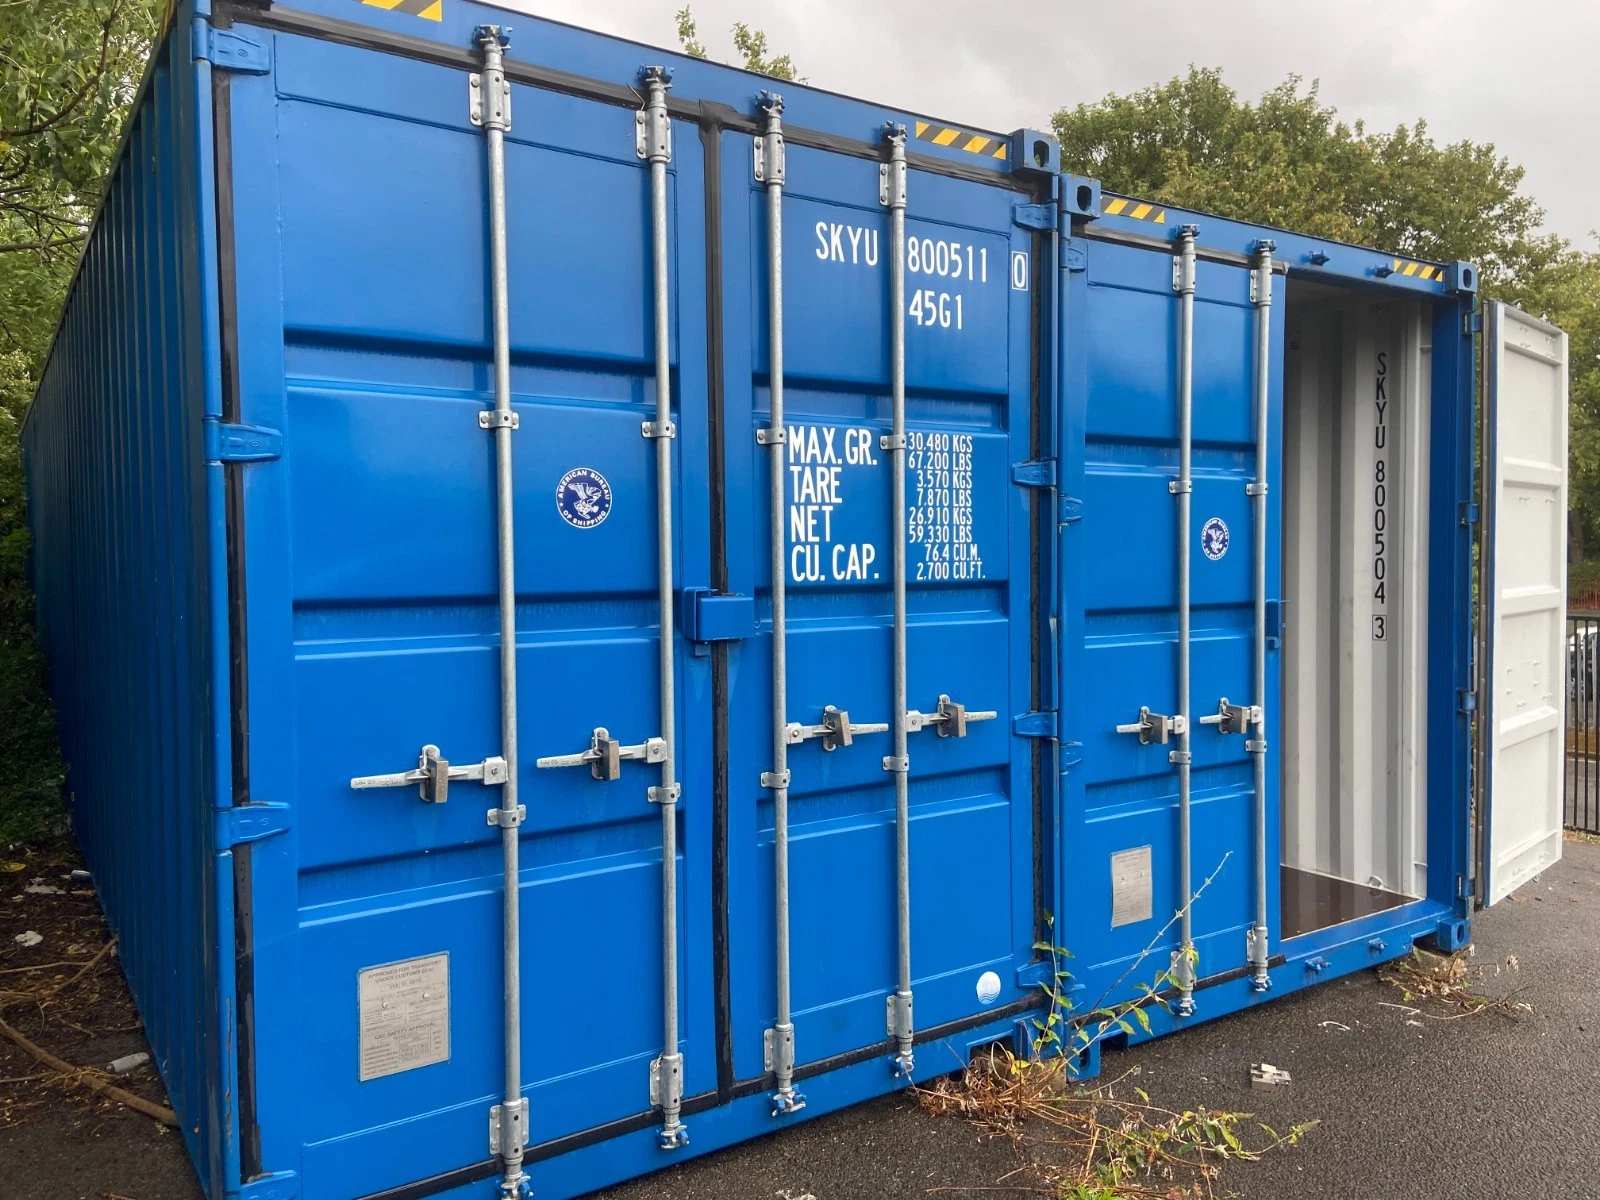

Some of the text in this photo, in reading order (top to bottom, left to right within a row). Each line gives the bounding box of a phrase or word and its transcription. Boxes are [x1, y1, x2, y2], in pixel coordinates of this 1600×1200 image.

[815, 221, 1027, 289] SKYU 800511 0
[909, 289, 962, 330] 45G1
[908, 432, 973, 453] 30,480 KGS
[908, 451, 972, 471] 67,200 LBS
[557, 470, 611, 500] AMERICAN BUREAU
[789, 465, 843, 504] TARE
[916, 470, 973, 489] 3,570 KGS
[916, 488, 972, 507] 7,870 LBS
[1374, 352, 1387, 639] SKYU 800504 3
[562, 509, 607, 526] OF SHIPPING
[790, 505, 834, 543] NET
[909, 506, 973, 525] 26,910 KGS
[909, 525, 973, 543] 59,330 LBS
[924, 543, 950, 562] 76.4
[791, 543, 880, 582] CU. CAP.
[916, 562, 950, 580] 2,700
[368, 960, 442, 979] APPROVED FOR TRANSPORT
[395, 970, 421, 979] CUSTOMS
[387, 1028, 408, 1037] SAFETY
